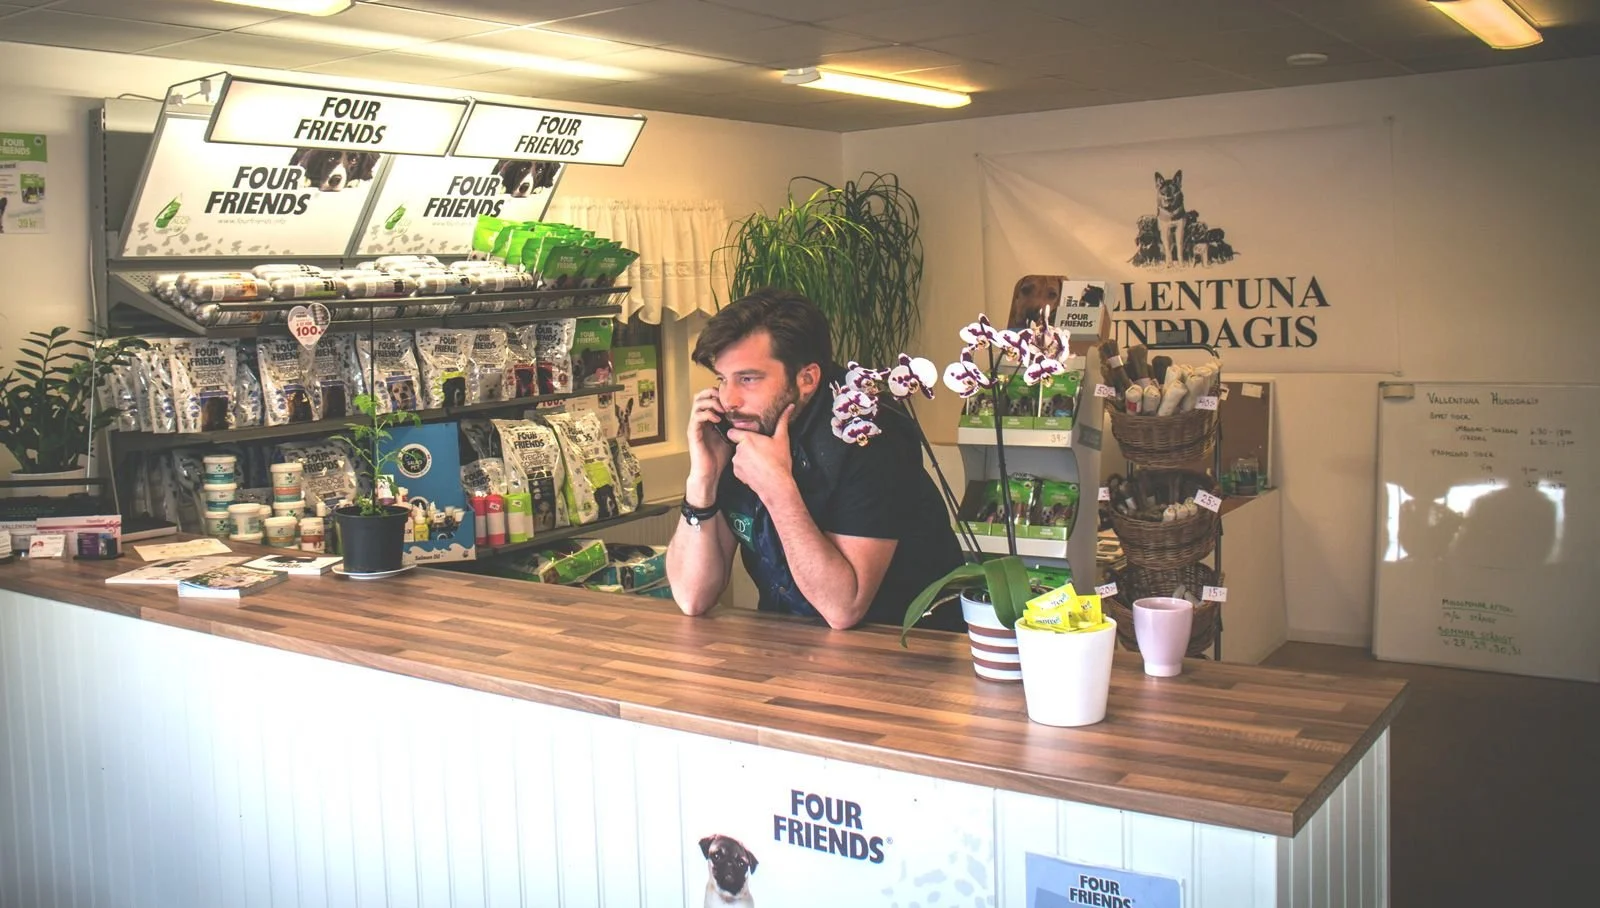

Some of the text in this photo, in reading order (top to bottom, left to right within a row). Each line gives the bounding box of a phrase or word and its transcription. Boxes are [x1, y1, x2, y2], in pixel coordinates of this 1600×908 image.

[320, 96, 381, 121] FOUR
[294, 119, 387, 144] FRIENDS
[536, 116, 582, 136] FOUR
[3, 138, 25, 147] FOUR
[514, 135, 583, 156] FRIENDS
[232, 166, 302, 190] FOUR
[447, 176, 501, 196] FOUR
[204, 191, 311, 215] FRIENDS
[423, 197, 505, 217] FRIENDS
[1113, 275, 1331, 312] LENTUNA
[440, 336, 457, 344] FOUR
[1112, 315, 1318, 349] NDAGIS
[190, 356, 225, 366] FRIENDS
[196, 347, 218, 356] FOUR
[1427, 392, 1480, 405] VALLENTUNA
[513, 438, 545, 449] FRIENDS
[517, 432, 538, 440] FOUR
[791, 789, 863, 830] FOUR
[773, 814, 884, 864] FRIENDS
[1080, 875, 1120, 895] FOUR
[1070, 888, 1131, 908] FRIENDS
